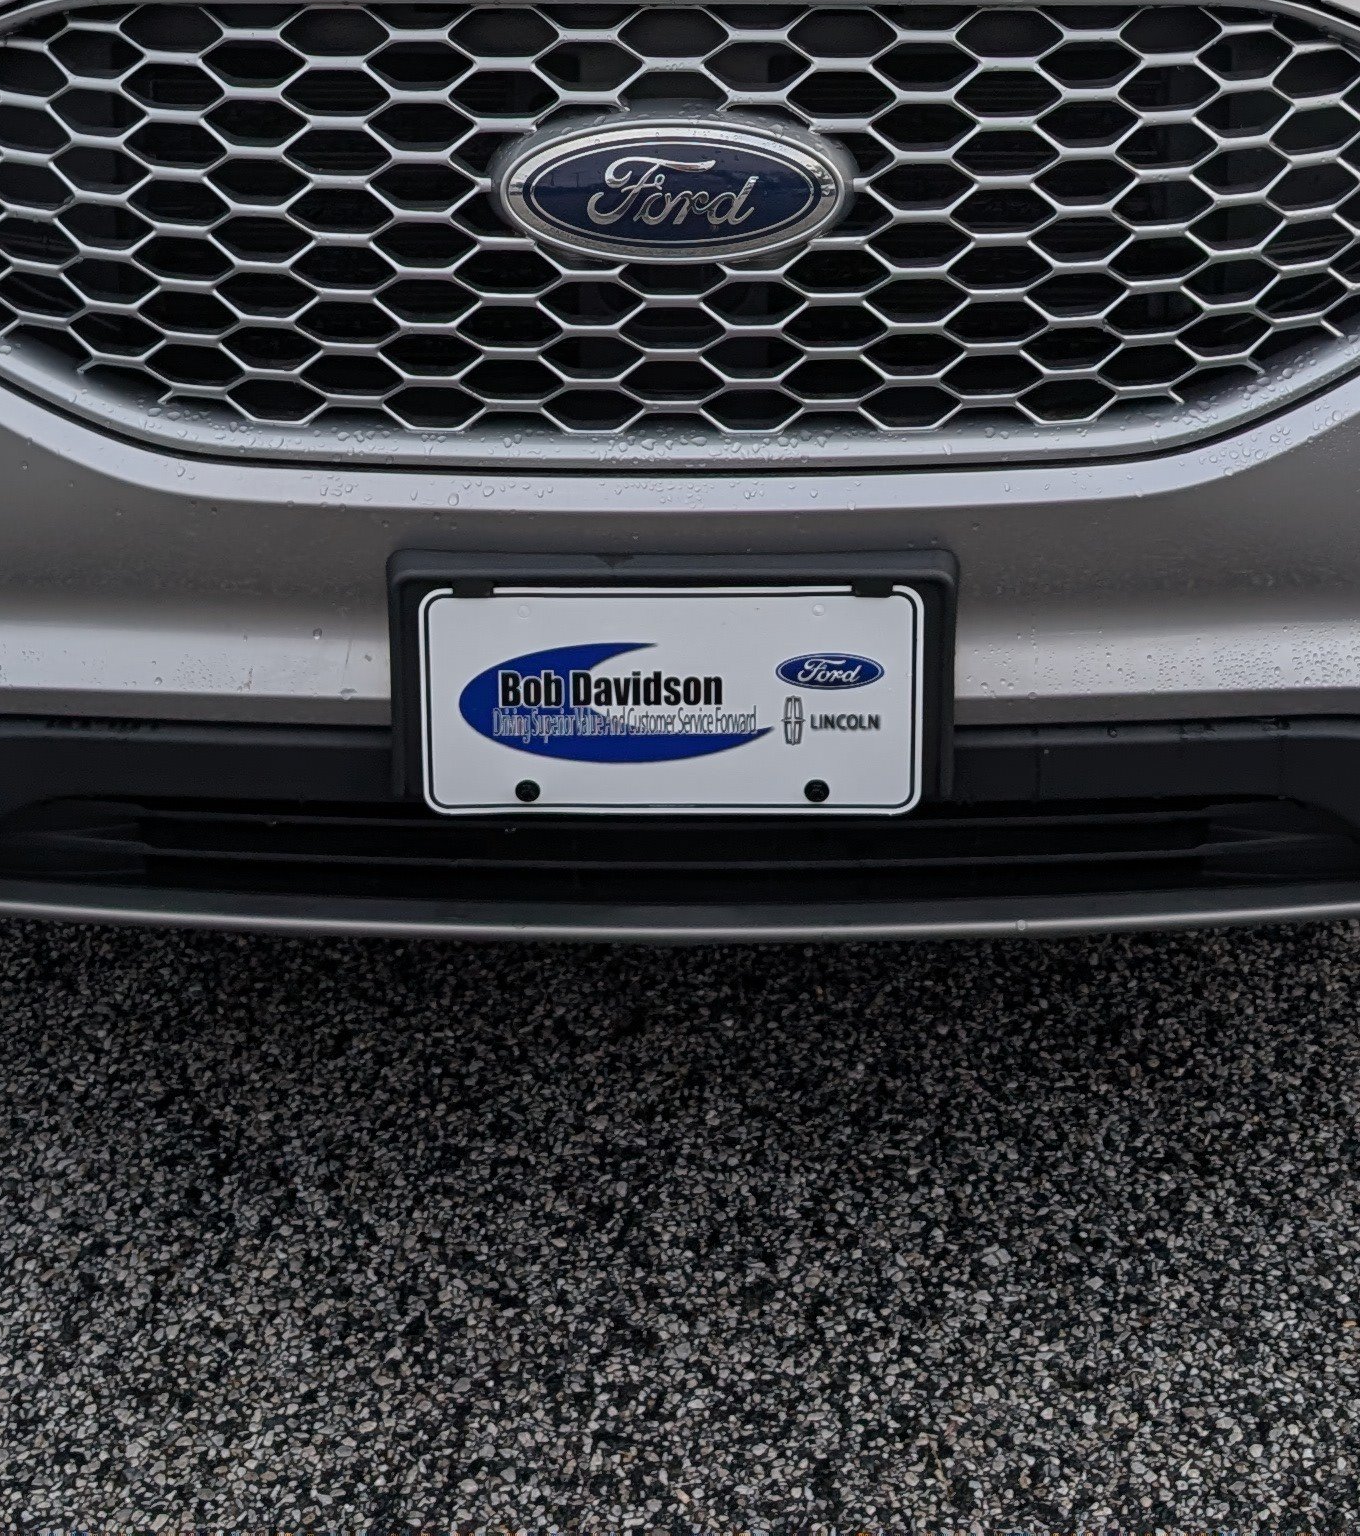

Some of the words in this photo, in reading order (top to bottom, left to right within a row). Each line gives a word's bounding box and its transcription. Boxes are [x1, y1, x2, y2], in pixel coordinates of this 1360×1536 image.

[586, 155, 761, 226] Ford
[499, 670, 565, 708] Bob
[570, 670, 723, 707] Davidson
[797, 658, 863, 683] Ford
[493, 707, 531, 744] Driving
[531, 707, 575, 744] Superior
[575, 707, 606, 736] Value
[604, 706, 627, 735] And
[627, 707, 676, 735] Customer
[677, 707, 714, 735] Service
[715, 705, 758, 735] Forward
[810, 713, 881, 731] LINCOLN
